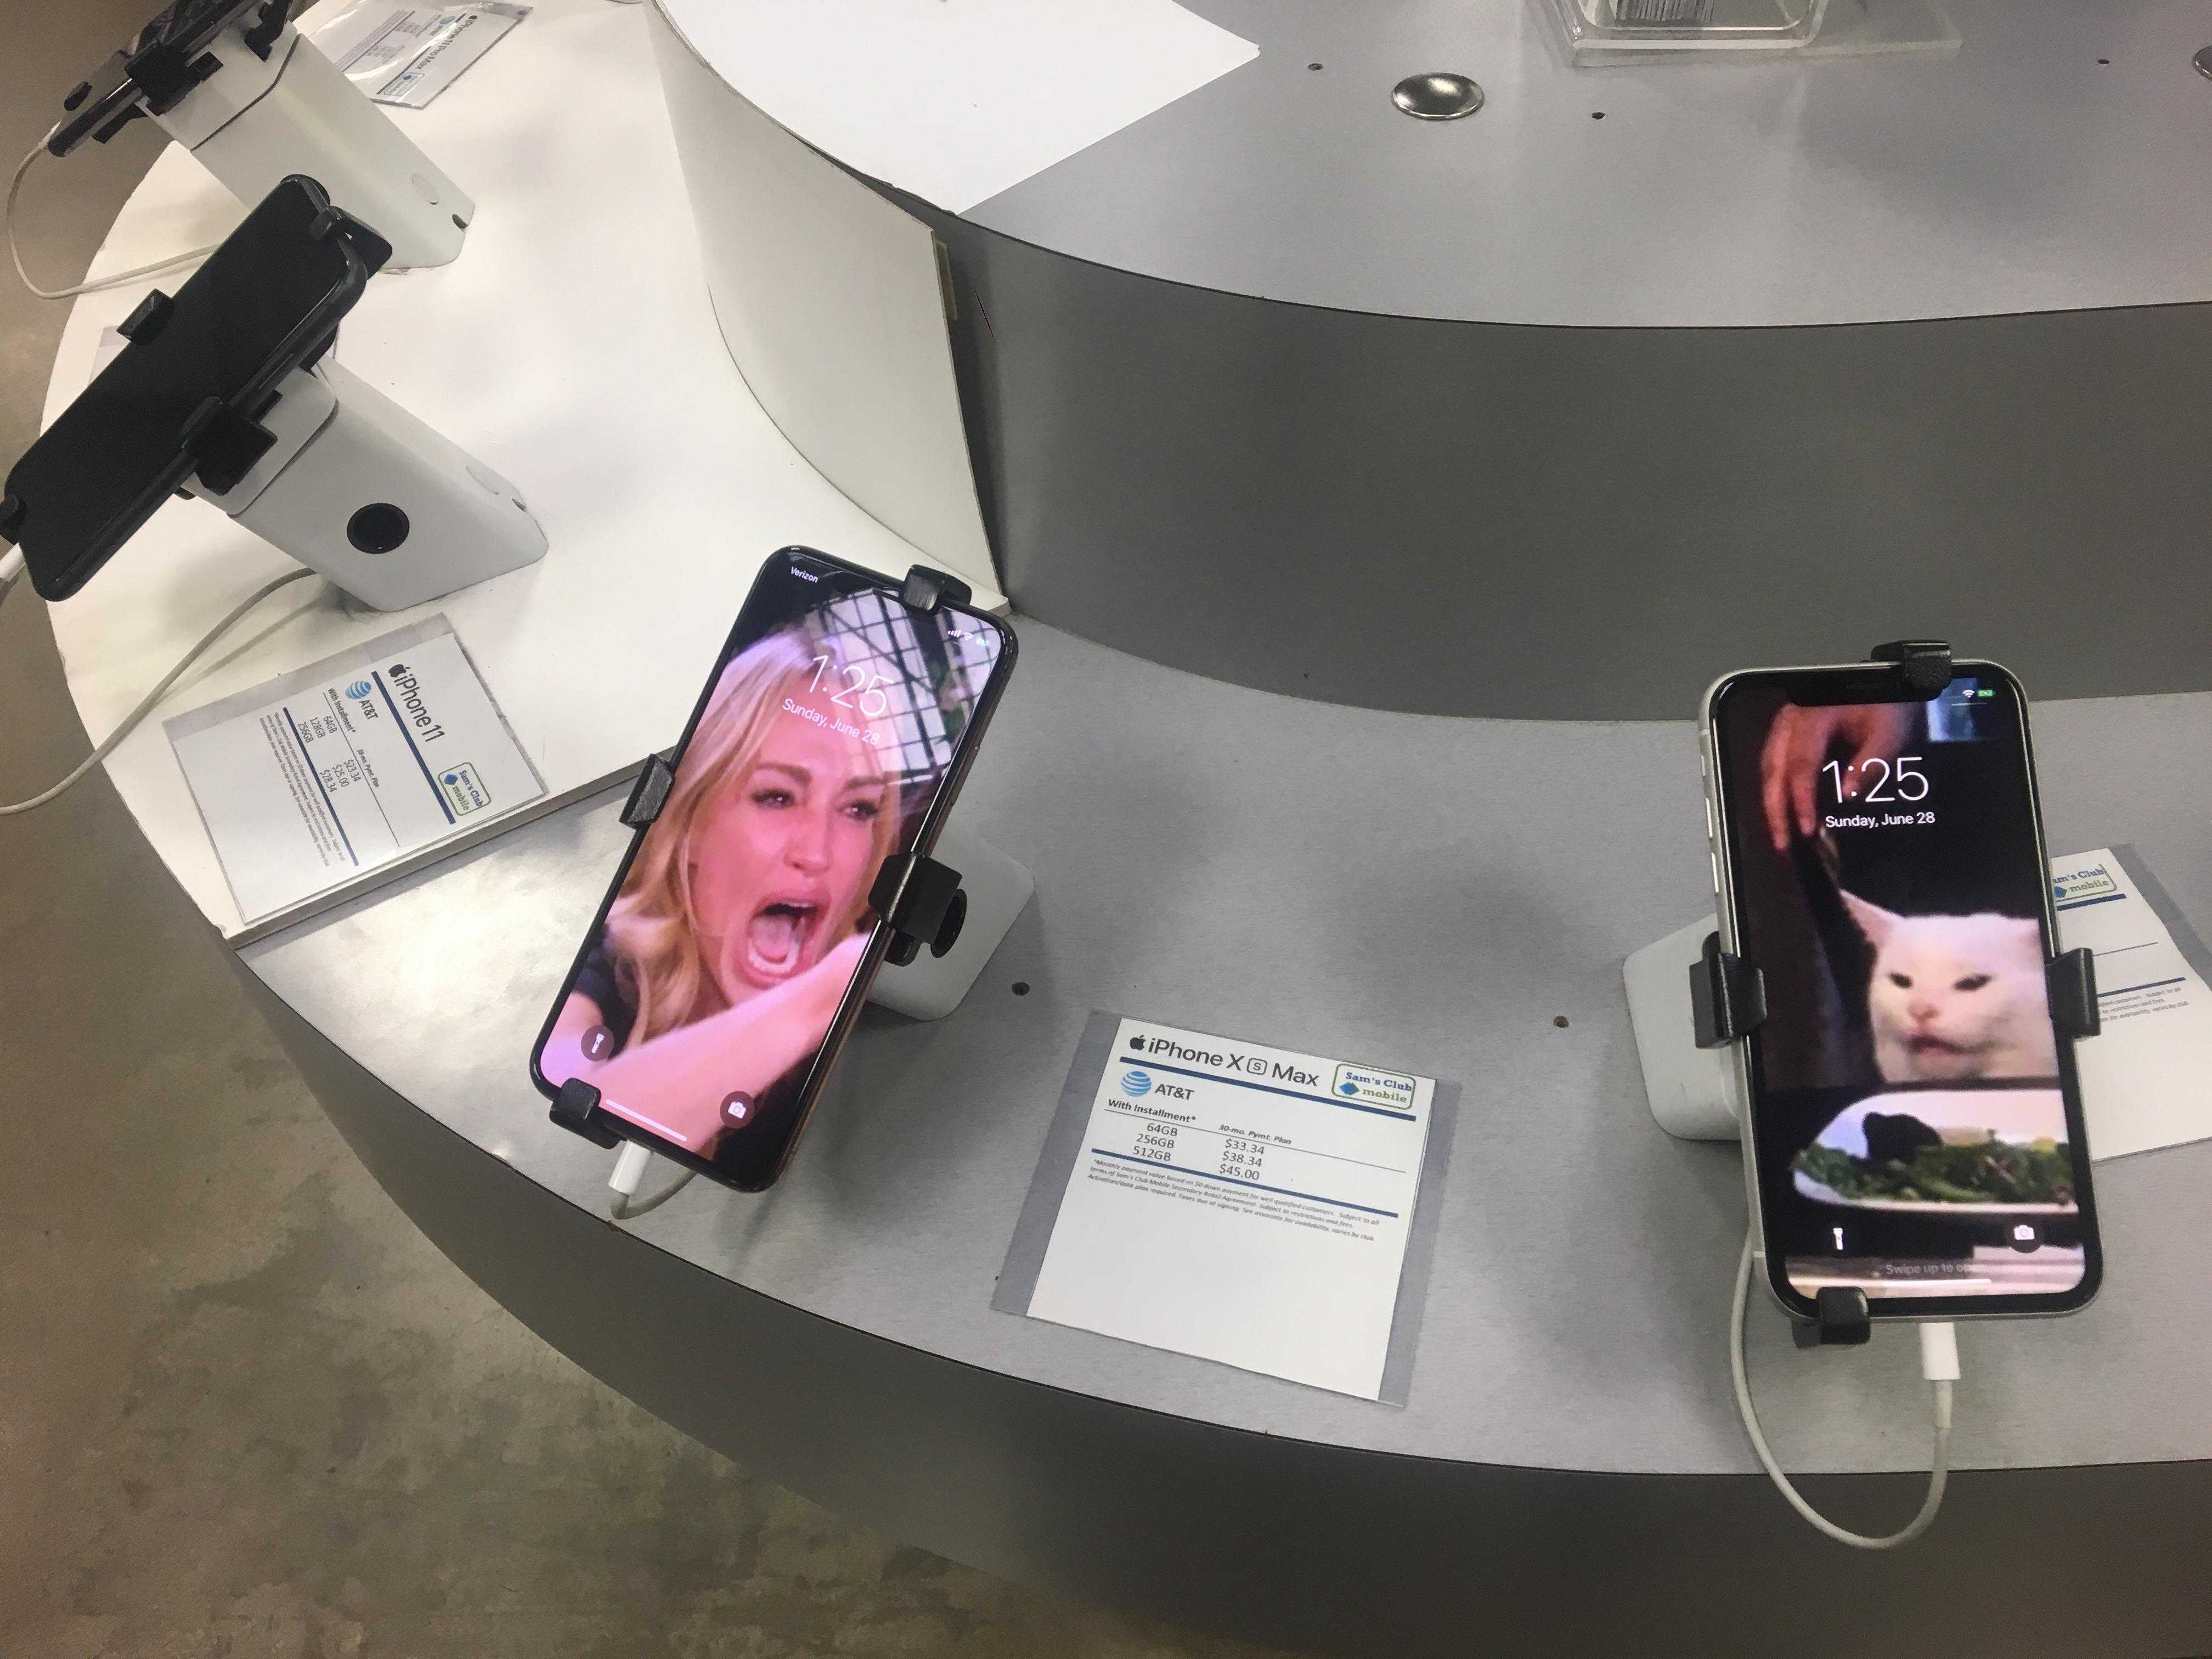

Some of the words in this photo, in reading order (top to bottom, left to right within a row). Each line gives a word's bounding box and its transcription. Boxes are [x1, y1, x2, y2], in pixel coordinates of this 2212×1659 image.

[790, 566, 819, 583] Verizon
[326, 687, 340, 702] With
[809, 654, 895, 718] 1:25
[358, 698, 379, 720] AT&T
[393, 673, 432, 727] iPhone
[420, 724, 445, 743] 11
[782, 698, 827, 728] Sunday,
[830, 718, 860, 738] June
[861, 731, 881, 745] 28
[296, 720, 314, 743] 256GB
[318, 768, 338, 793] $28.34
[308, 716, 326, 739] 128GB
[330, 763, 350, 788] $25.00
[322, 714, 338, 734] 64GB
[342, 758, 362, 782] $23.34
[370, 776, 379, 788] Plan
[458, 769, 474, 791] Sam's
[469, 789, 484, 808] Club
[1822, 757, 1929, 803] 1:25
[451, 785, 470, 811] mobile
[1825, 815, 1878, 829] Sunday,
[1881, 813, 1914, 826] June
[1916, 811, 1936, 823] 28
[2053, 874, 2078, 883] am's
[2078, 868, 2104, 878] Club
[2069, 880, 2109, 892] mobile
[1148, 1037, 1223, 1066] iPhone
[1225, 1052, 1245, 1071] X
[1271, 1062, 1319, 1087] Max
[1154, 1082, 1195, 1101] AT&T
[1345, 1071, 1381, 1085] Sam's
[1383, 1079, 1412, 1091] Club
[1107, 1098, 1132, 1111] With
[1362, 1088, 1407, 1103] mobile
[1146, 1122, 1178, 1137] 64GB
[1224, 1137, 1265, 1155] $33.34
[1218, 1124, 1245, 1135] 30-mo.
[1248, 1130, 1271, 1141] Pymt.
[1273, 1135, 1291, 1144] Plan
[1136, 1132, 1175, 1149] 256GB
[1221, 1149, 1262, 1167] $38.34
[1132, 1144, 1171, 1162] 512GB
[1218, 1163, 1260, 1181] $45.00
[1886, 1265, 1920, 1276] Swipe
[1923, 1265, 1939, 1275] up
[1942, 1263, 1953, 1272] to
